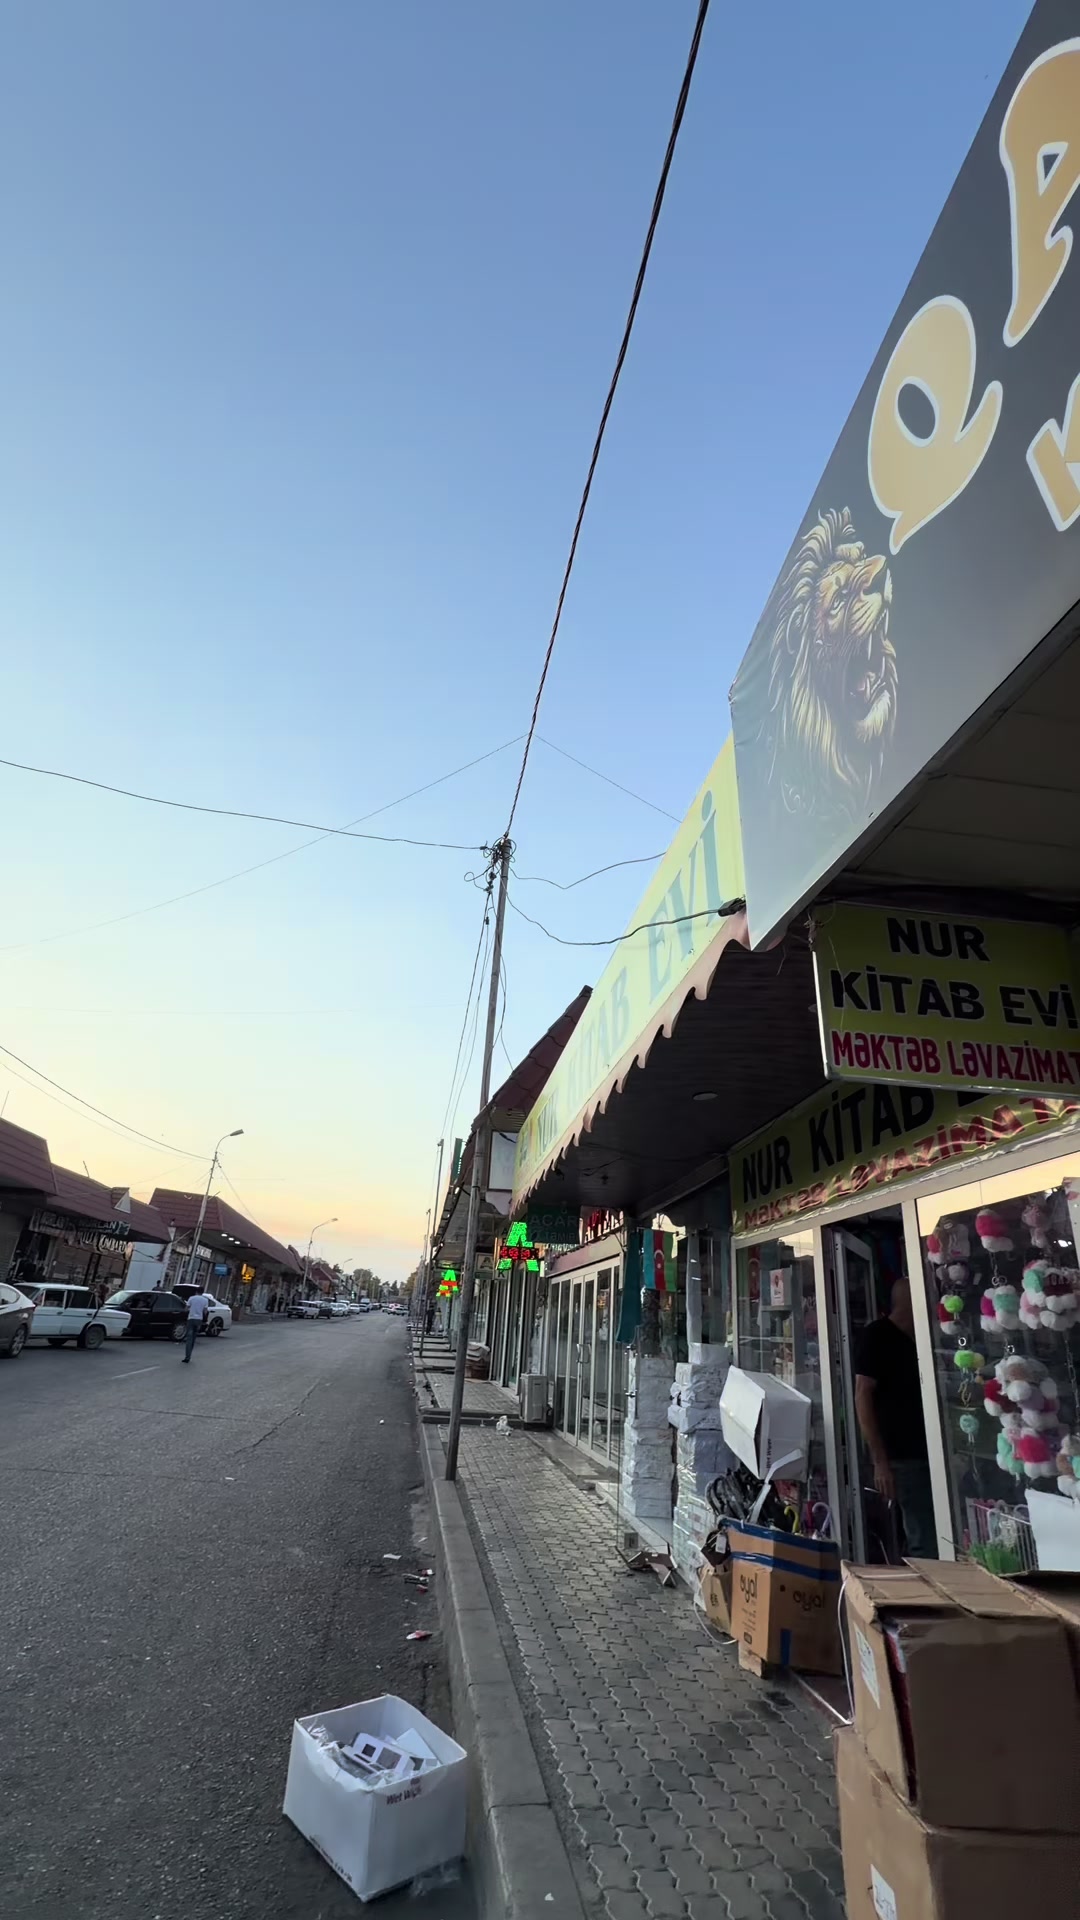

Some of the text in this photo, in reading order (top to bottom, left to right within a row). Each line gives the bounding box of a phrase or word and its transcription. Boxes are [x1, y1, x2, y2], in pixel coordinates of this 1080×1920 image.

[646, 789, 723, 1005] EVİ
[886, 917, 991, 962] NUR
[829, 965, 1078, 1030] KİTAB EVİ
[831, 1030, 941, 1074] MƏKTƏB
[742, 1085, 935, 1203] NUR KİTAB
